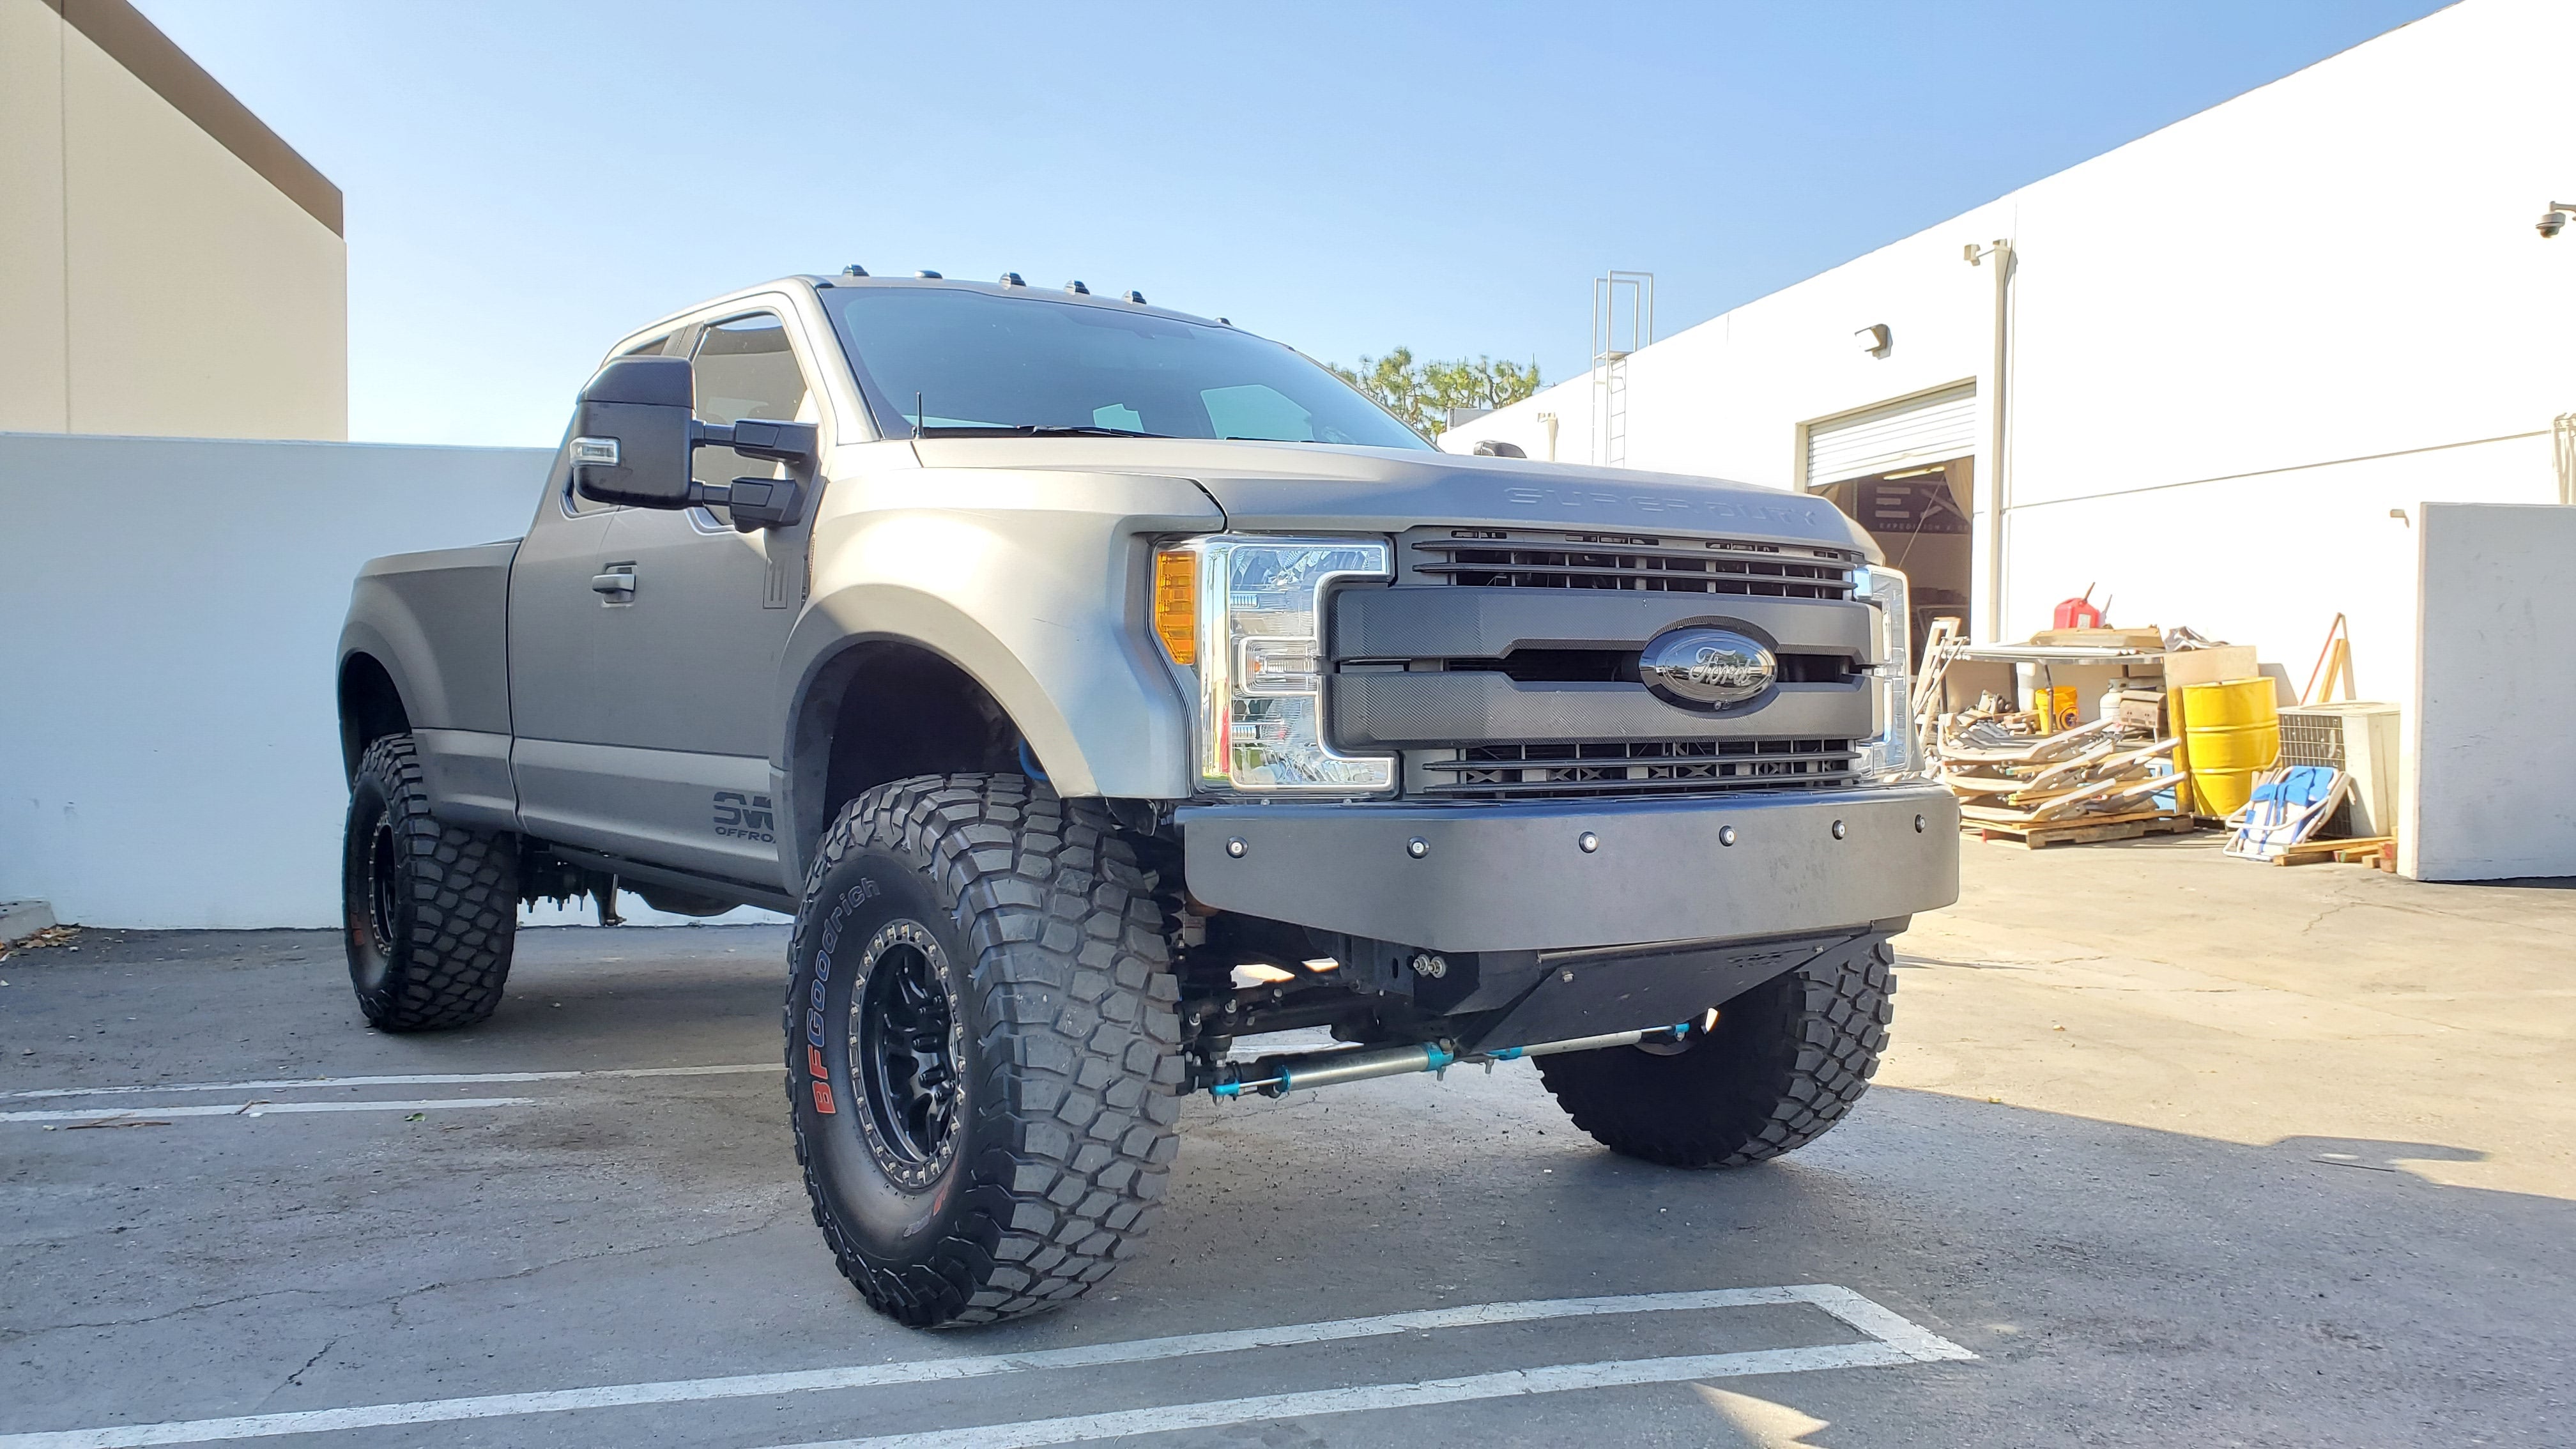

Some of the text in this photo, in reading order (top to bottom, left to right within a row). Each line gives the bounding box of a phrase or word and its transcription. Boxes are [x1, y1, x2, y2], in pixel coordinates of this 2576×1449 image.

[1503, 487, 1699, 516] SUPER
[1689, 646, 1751, 687] Ford
[715, 826, 776, 844] OFFRO
